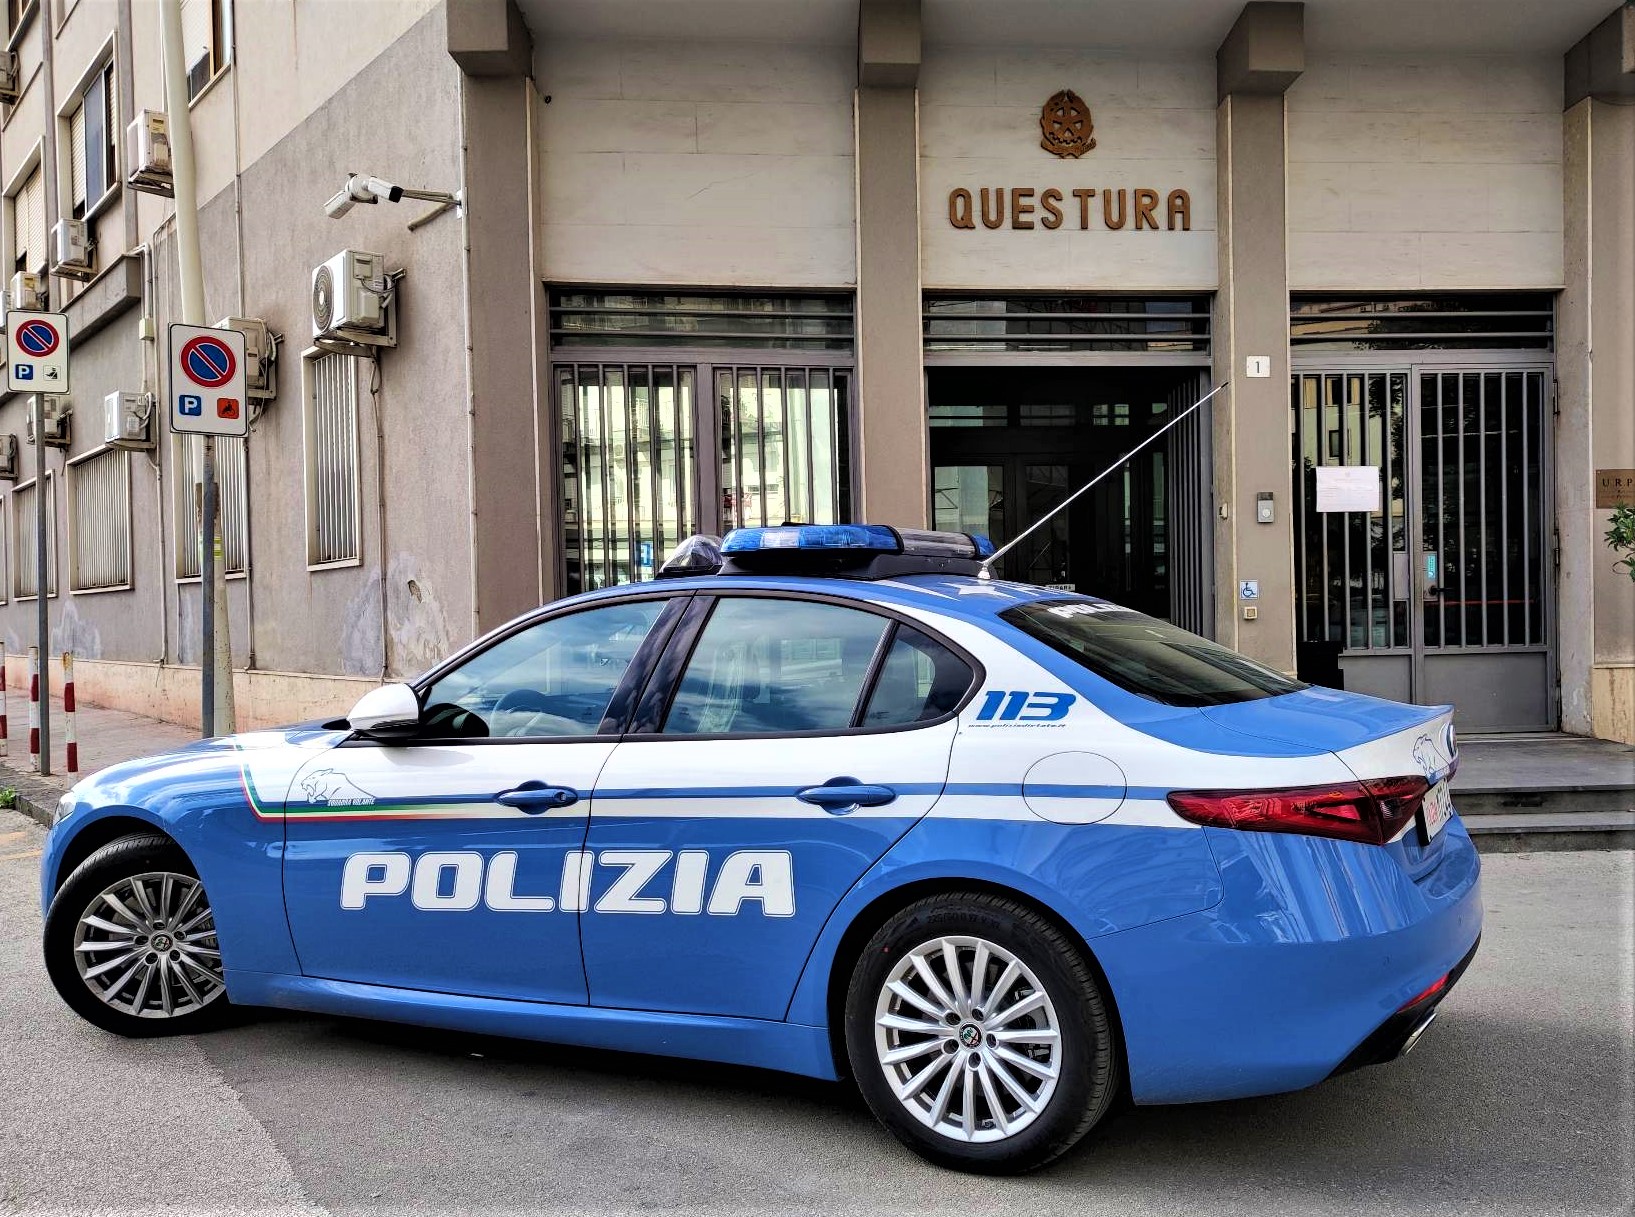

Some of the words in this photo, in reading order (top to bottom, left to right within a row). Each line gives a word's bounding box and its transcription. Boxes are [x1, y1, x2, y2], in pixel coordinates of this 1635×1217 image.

[949, 187, 1191, 231] QUESTURA
[18, 365, 30, 379] P
[1255, 361, 1260, 374] 1
[184, 397, 198, 414] P
[976, 690, 1077, 721] 113
[339, 850, 796, 917] POLIZIA
